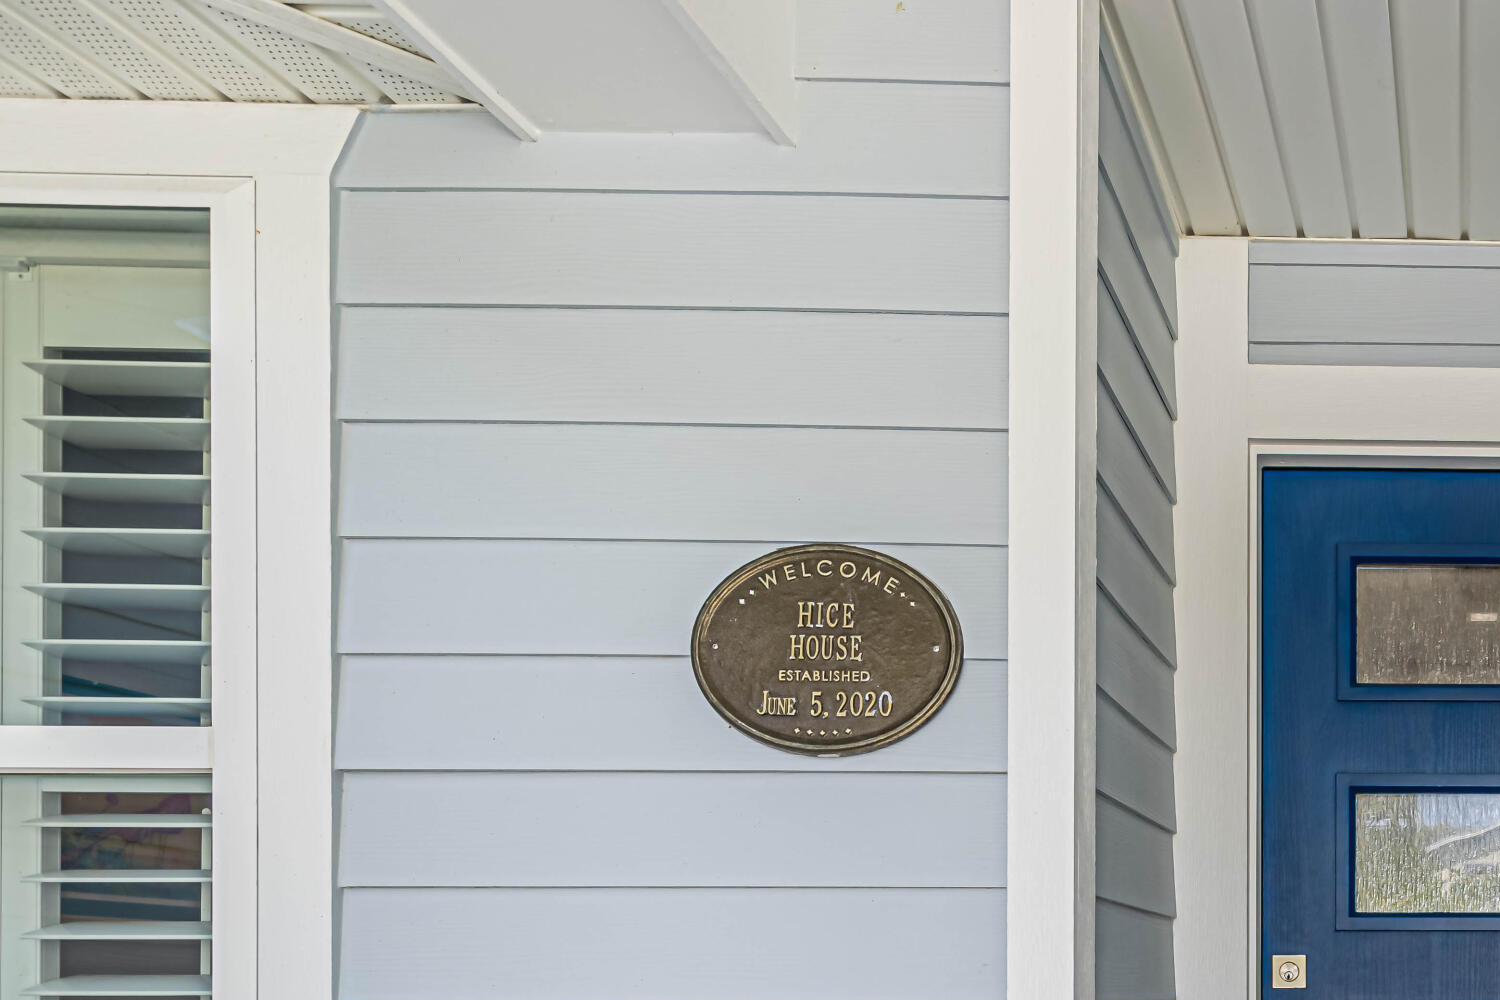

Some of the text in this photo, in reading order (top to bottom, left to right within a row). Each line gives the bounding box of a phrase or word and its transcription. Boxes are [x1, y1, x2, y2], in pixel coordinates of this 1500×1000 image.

[757, 559, 900, 595] WELCOME
[797, 601, 855, 628] HICE
[789, 634, 863, 661] HOUSE
[778, 669, 871, 682] ESTABLISHED
[810, 691, 829, 719] 5,
[836, 690, 893, 717] 2020
